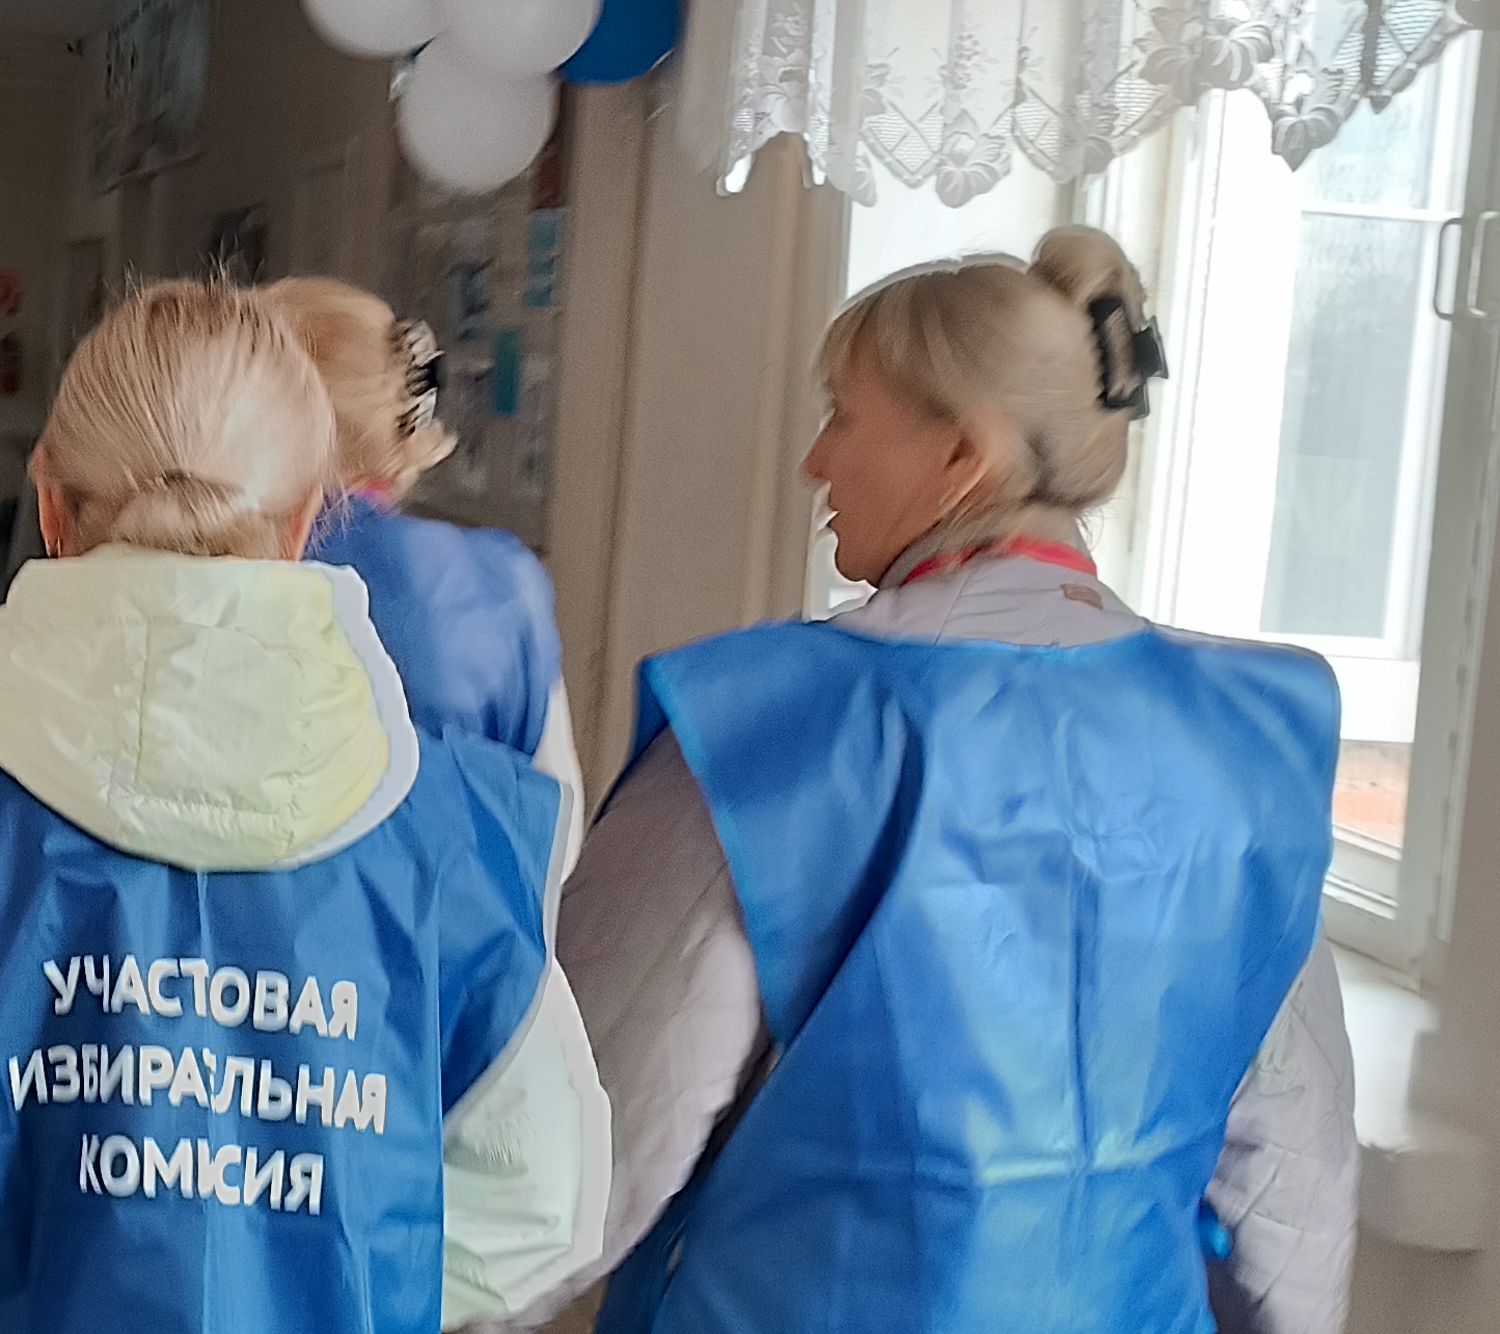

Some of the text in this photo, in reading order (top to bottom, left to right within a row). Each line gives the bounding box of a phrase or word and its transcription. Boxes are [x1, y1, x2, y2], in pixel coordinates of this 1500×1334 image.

[43, 954, 358, 1041] УЧАСТОВАЯ
[8, 1044, 388, 1135] ИЗБИРАЛЬНАЯ
[79, 1133, 324, 1216] КОМИСИЯ
